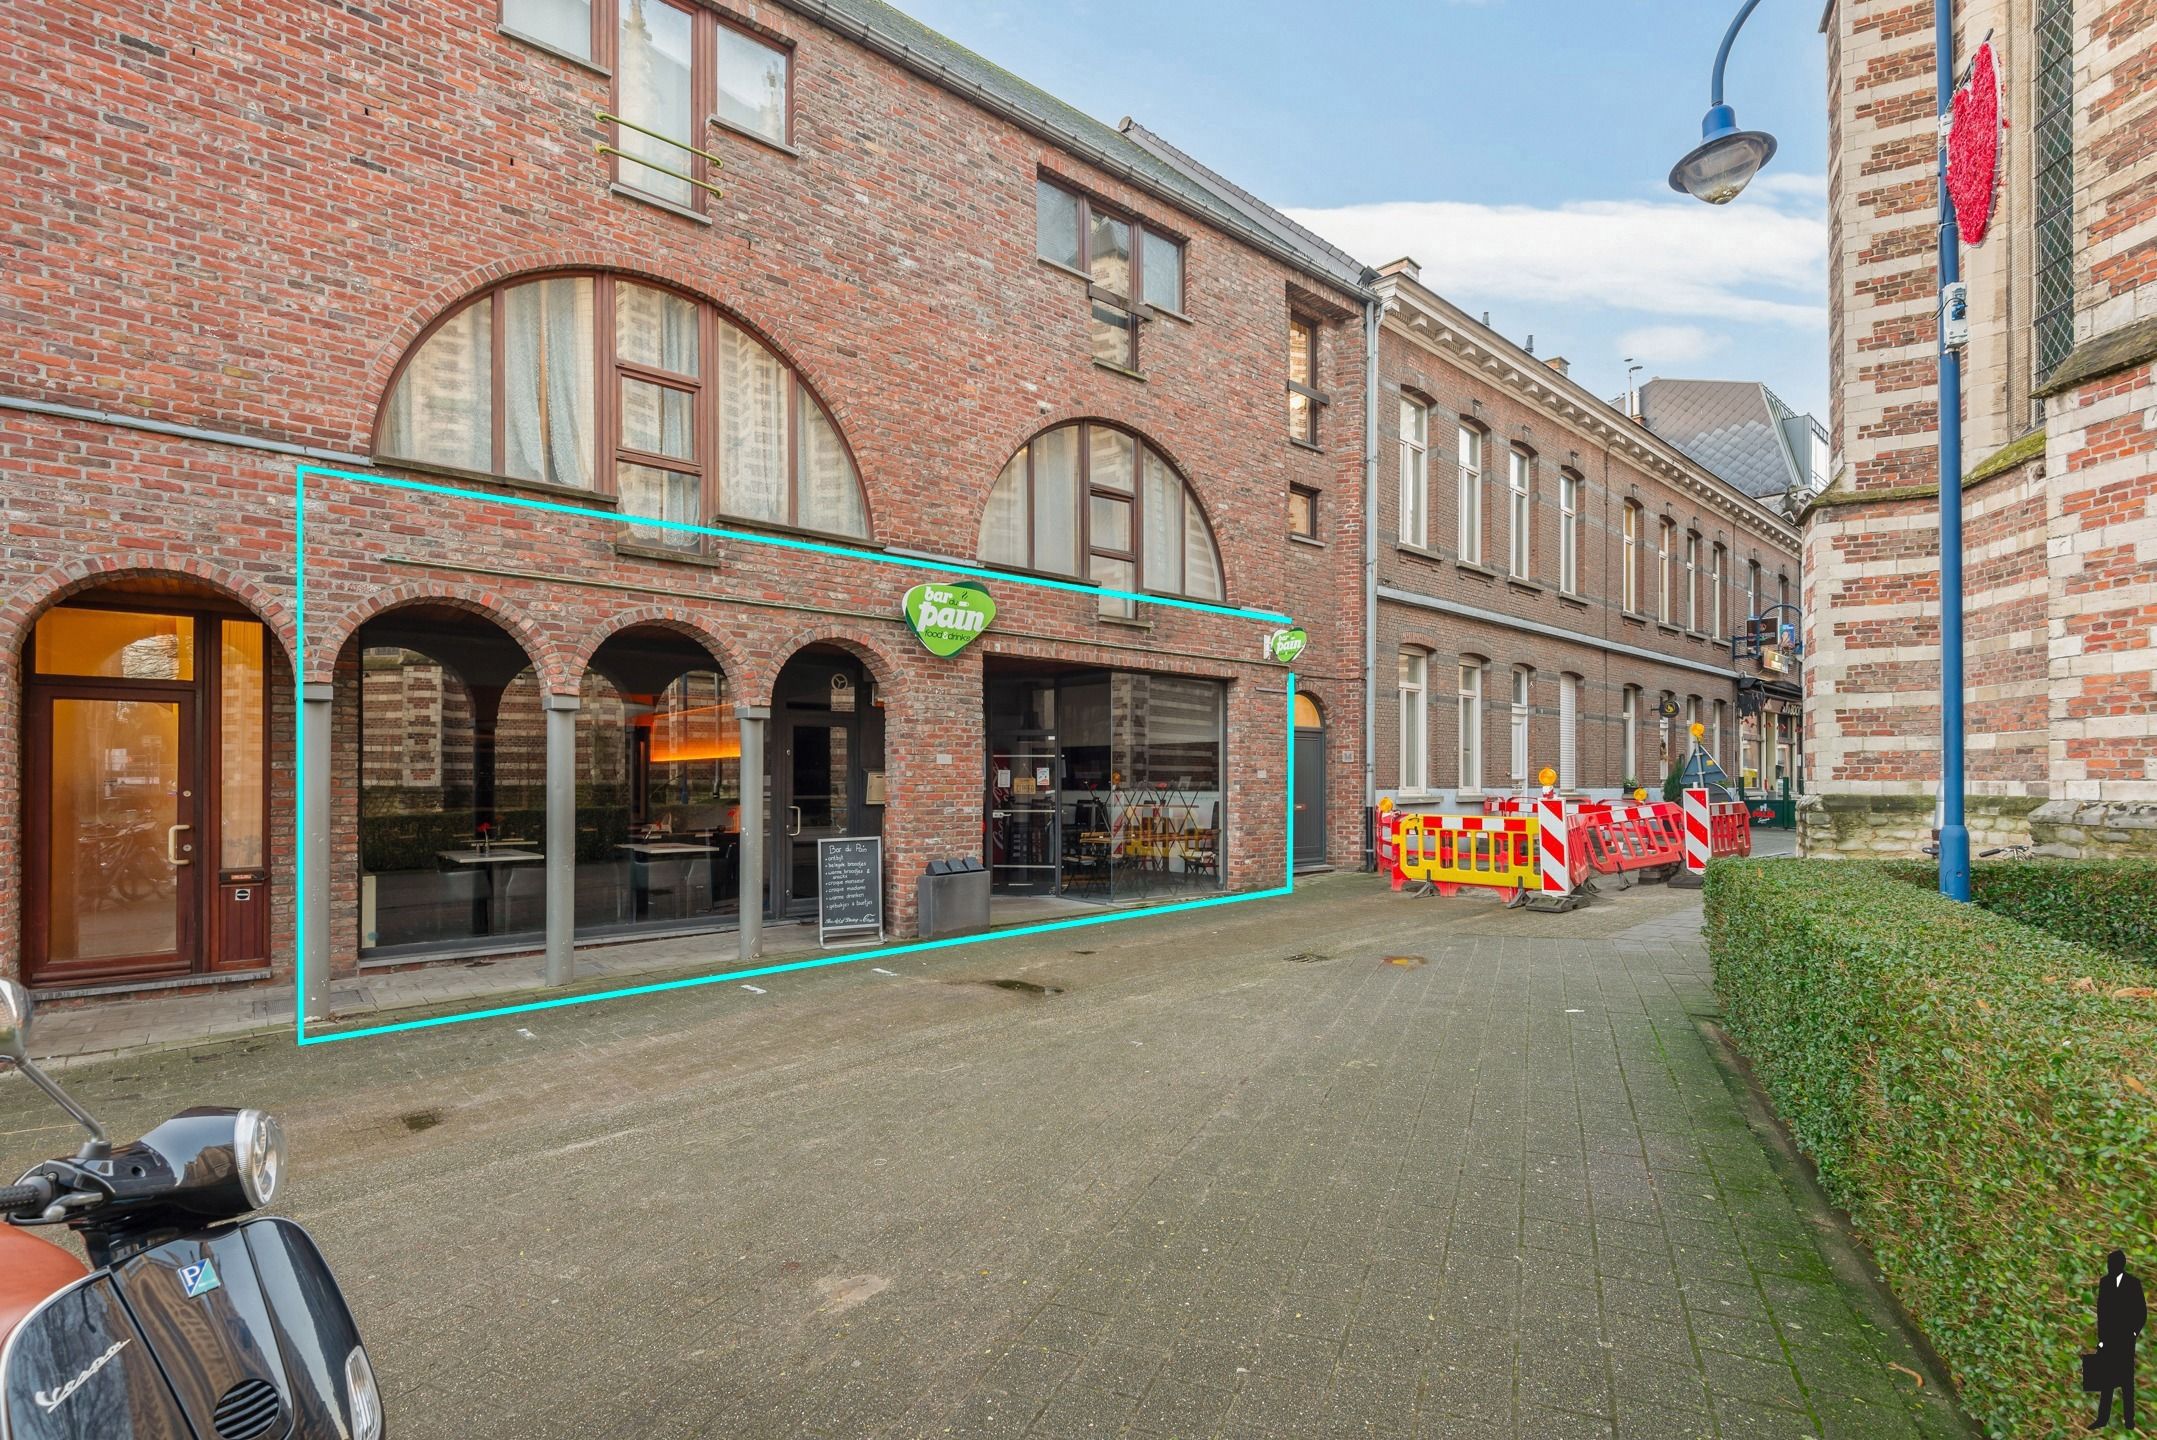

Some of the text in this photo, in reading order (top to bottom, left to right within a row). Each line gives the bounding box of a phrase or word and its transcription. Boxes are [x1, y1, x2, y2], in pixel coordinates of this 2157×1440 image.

[924, 586, 953, 603] bar
[948, 598, 958, 606] du
[917, 601, 985, 632] pain
[1276, 639, 1302, 655] pain
[829, 845, 841, 854] Bar
[855, 842, 867, 852] Pain
[182, 1265, 200, 1286] P
[35, 1338, 132, 1414] Vespa
